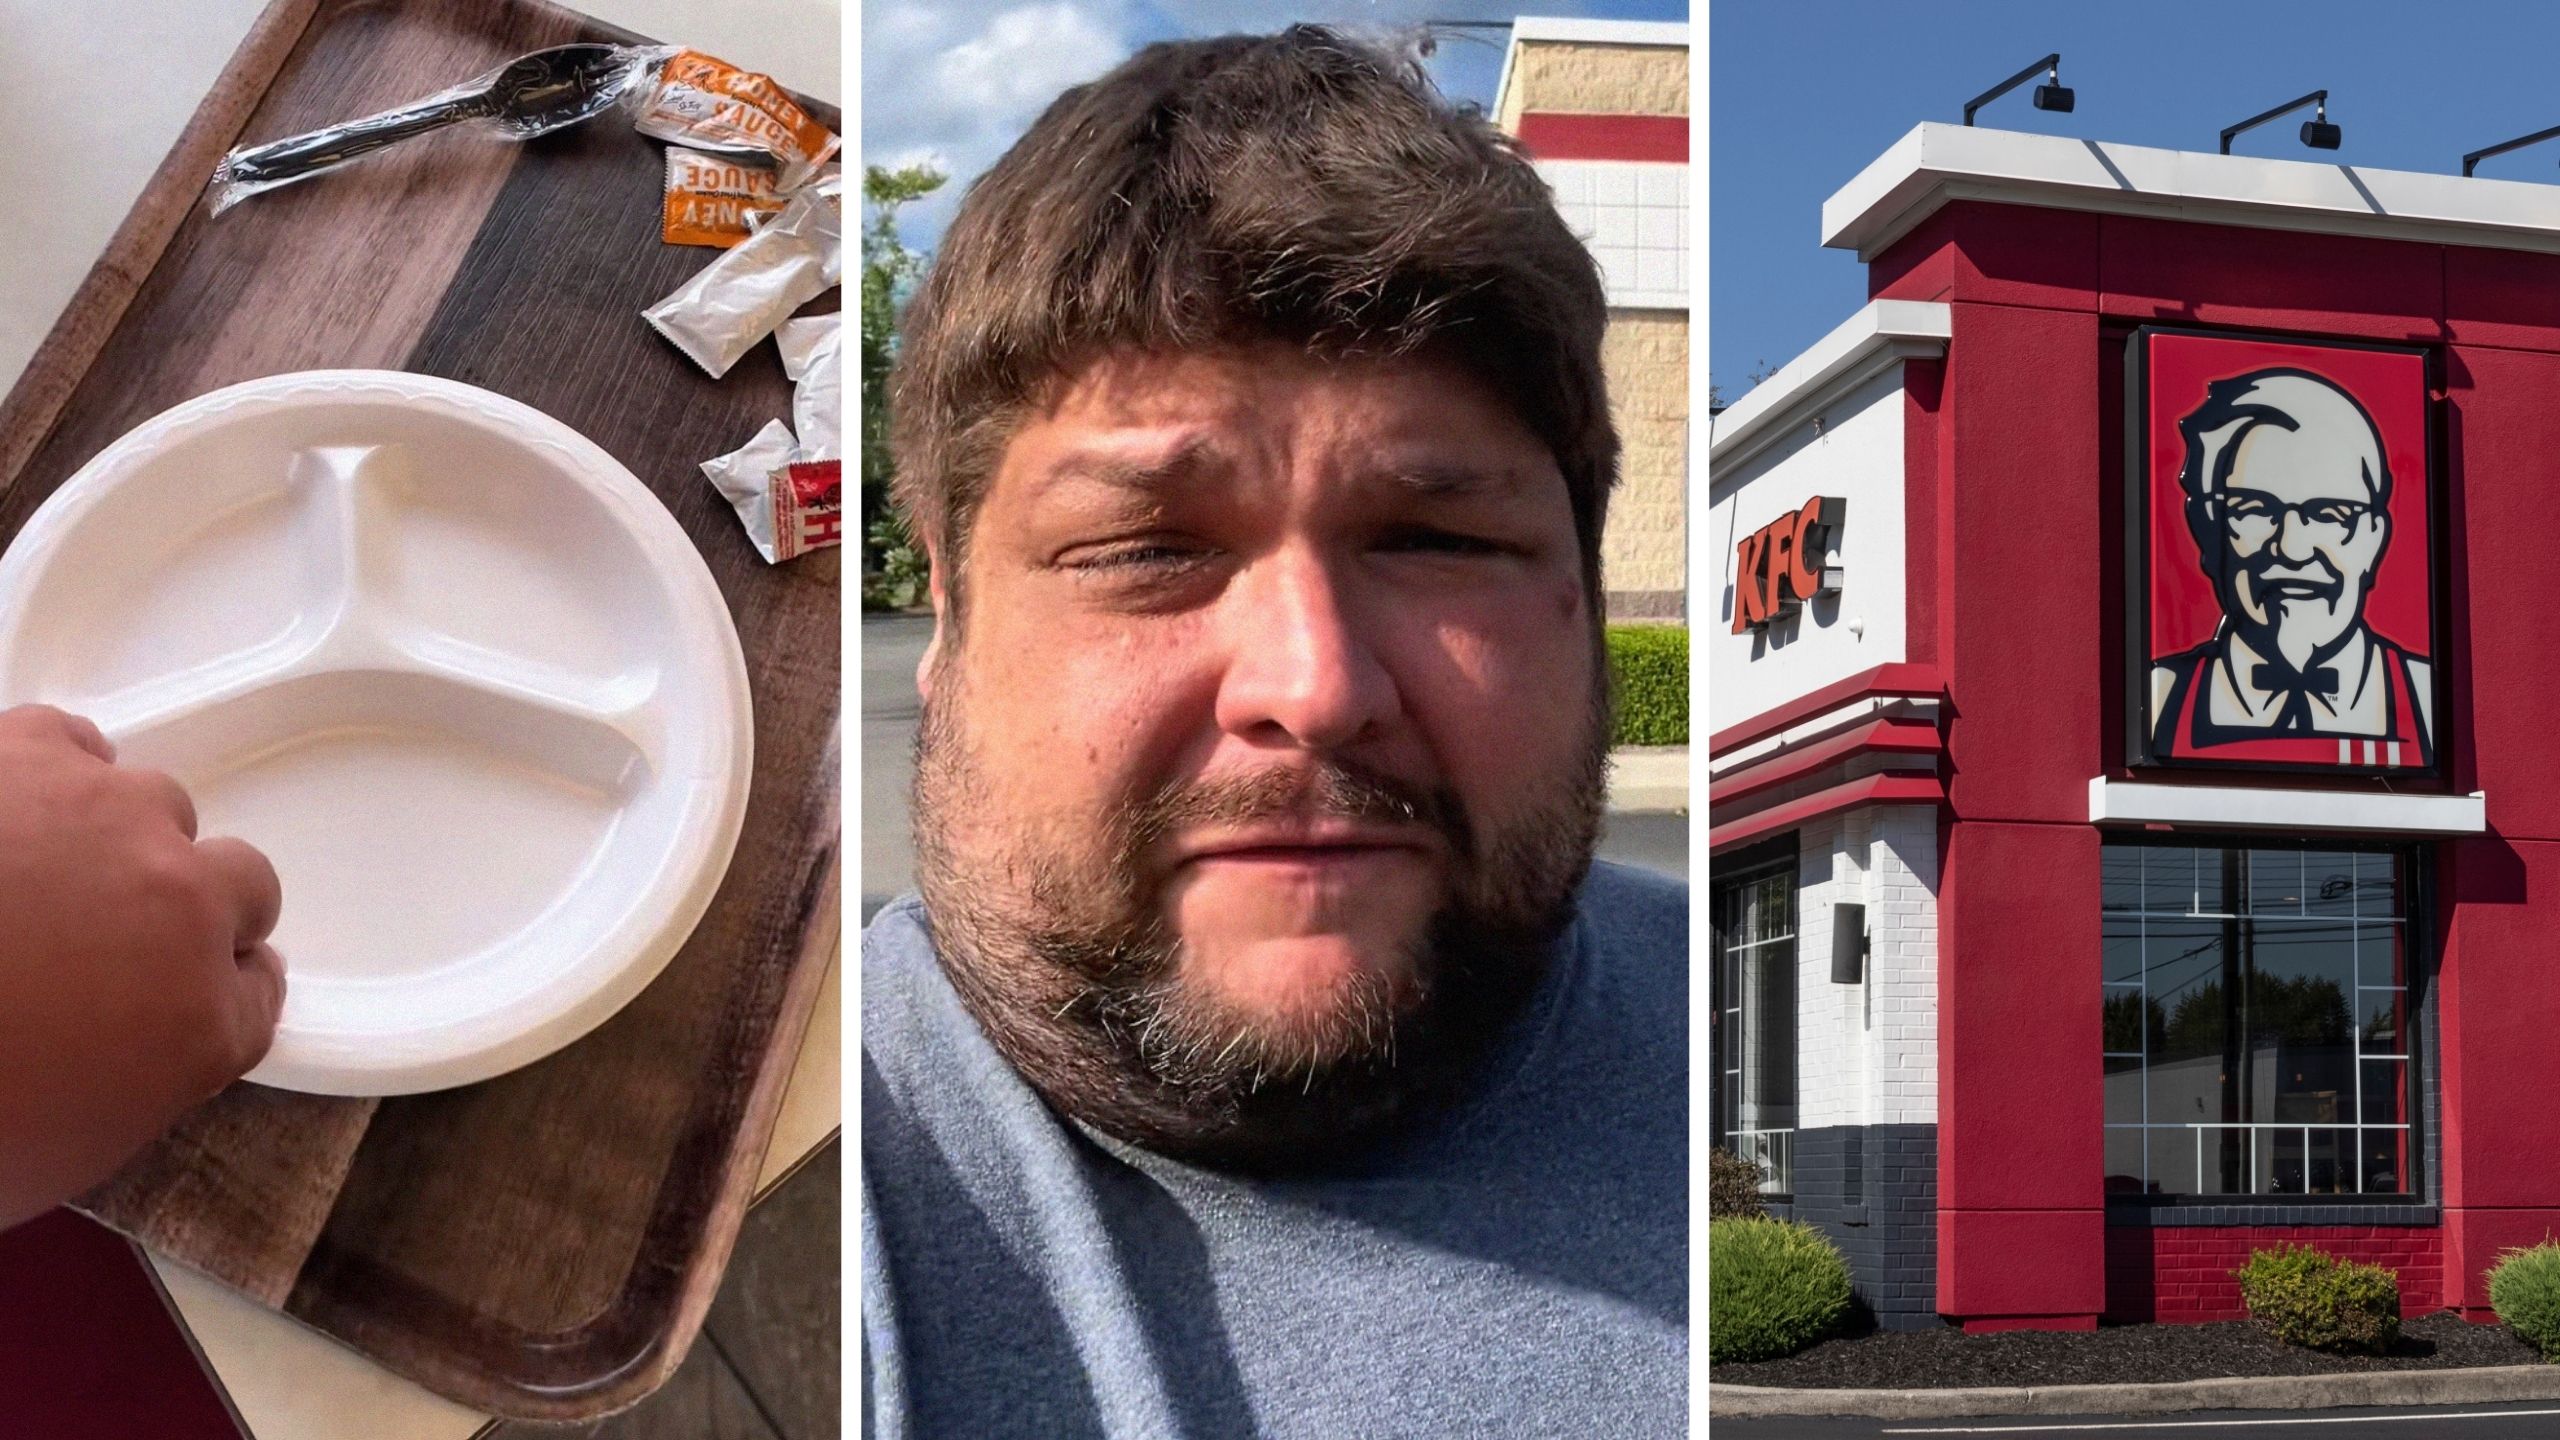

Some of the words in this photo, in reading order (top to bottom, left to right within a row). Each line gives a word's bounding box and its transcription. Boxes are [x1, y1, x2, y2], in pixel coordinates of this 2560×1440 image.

[713, 101, 798, 150] SAUCE
[727, 75, 810, 130] HONEY
[686, 165, 776, 194] SAUCE
[1732, 495, 1822, 636] KFC
